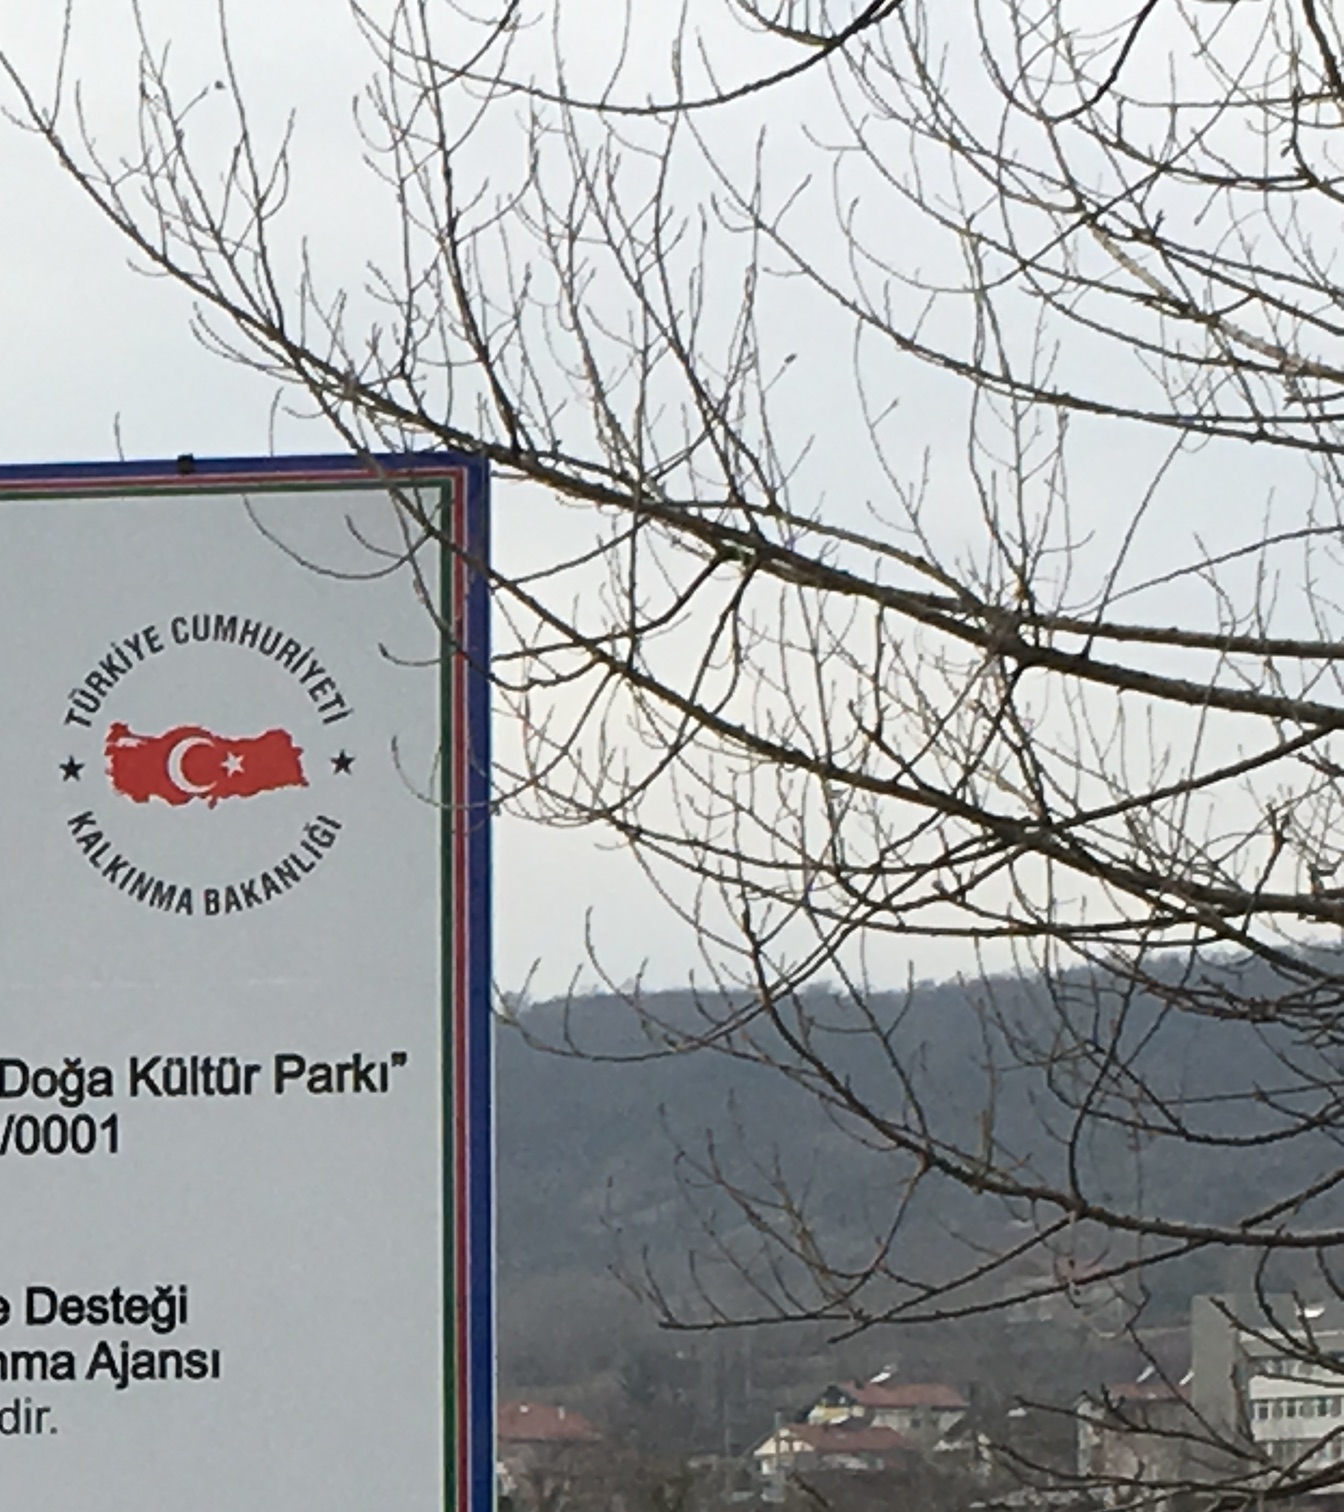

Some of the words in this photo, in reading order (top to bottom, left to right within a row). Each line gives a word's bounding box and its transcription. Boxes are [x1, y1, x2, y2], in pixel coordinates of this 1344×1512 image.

[63, 625, 165, 728] TÜRKİYE
[170, 614, 354, 725] CUMHURİYETİ
[67, 811, 194, 916] KALKINMA
[204, 815, 343, 916] BAKANLIĞI
[130, 1055, 261, 1098] Kültür
[25, 1284, 189, 1334] Desteği
[85, 1339, 221, 1389] Ajansı
